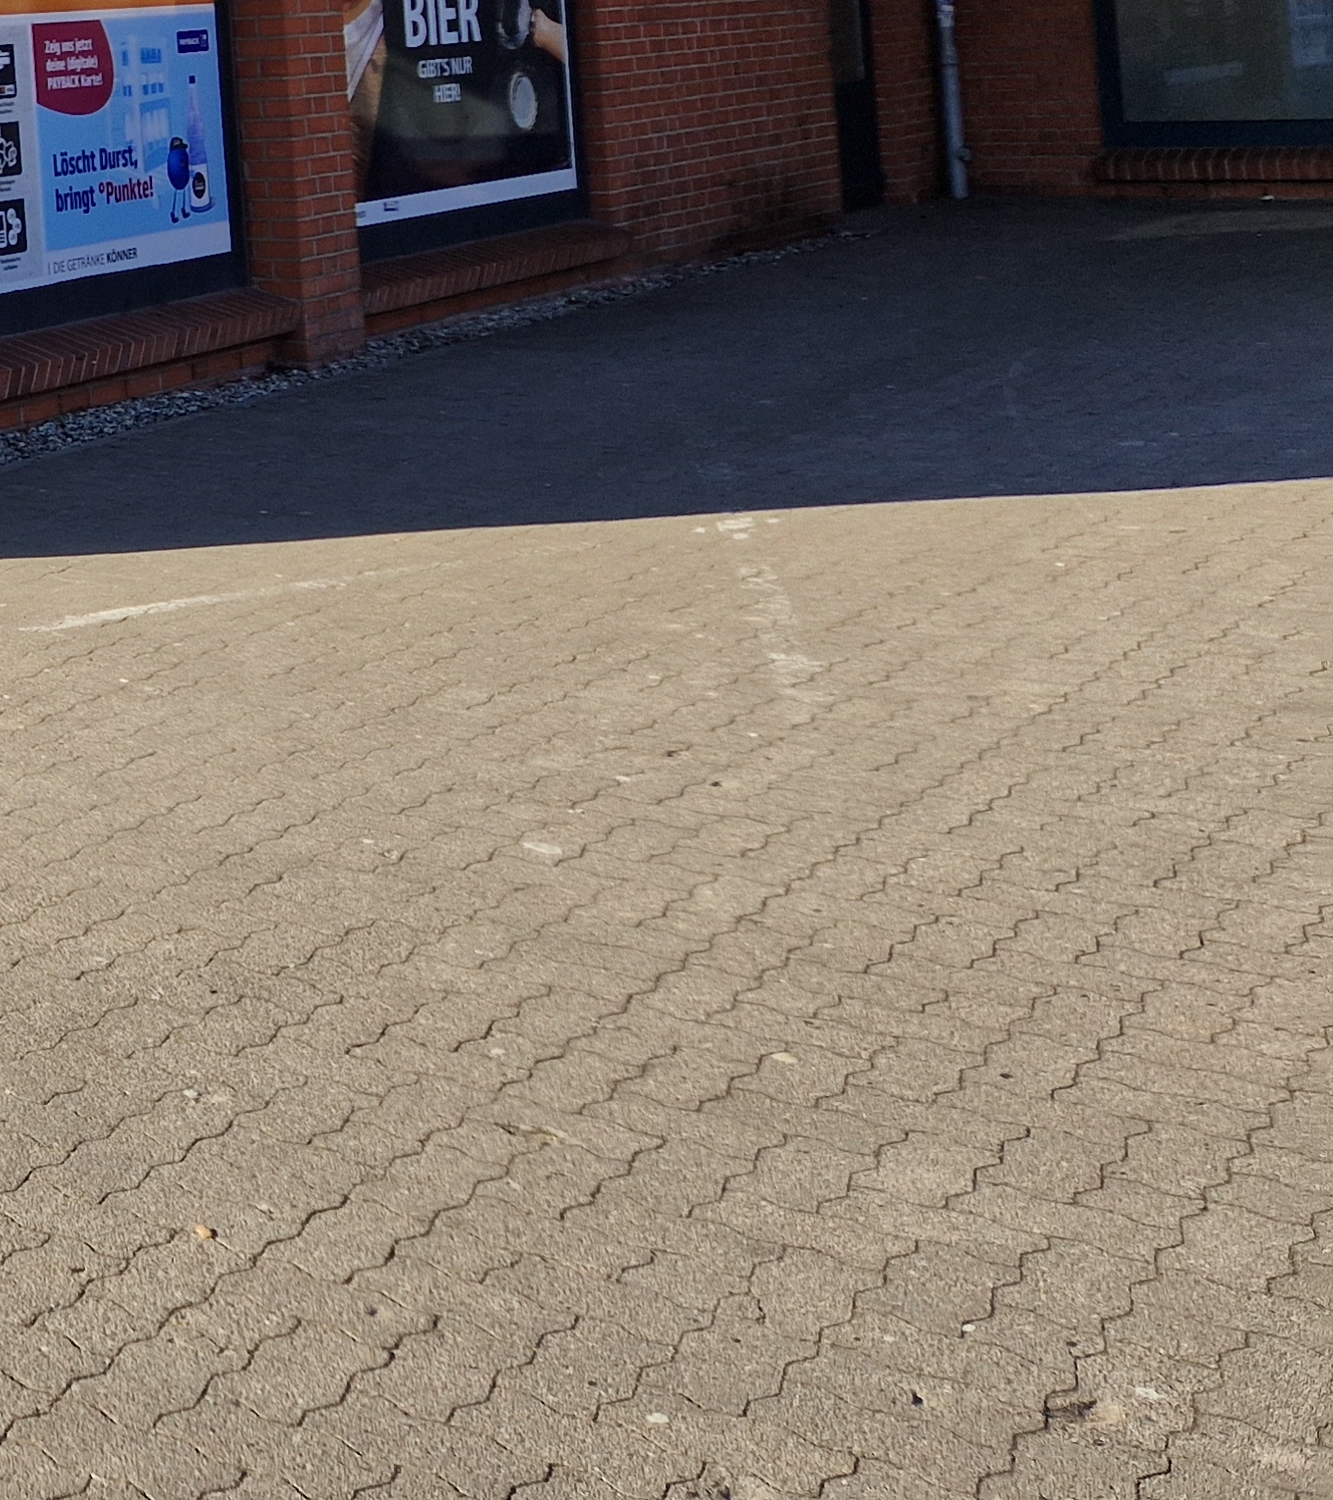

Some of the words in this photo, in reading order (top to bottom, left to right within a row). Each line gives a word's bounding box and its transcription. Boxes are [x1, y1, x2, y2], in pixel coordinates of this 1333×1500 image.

[44, 39, 61, 55] Zeig
[451, 56, 473, 75] NUR
[53, 149, 97, 177] Löscht
[99, 145, 138, 171] Durst,
[55, 185, 96, 214] bringt
[53, 261, 66, 275] DIE
[67, 253, 105, 272] GETRÄNKE
[106, 248, 138, 264] KÖNNER
